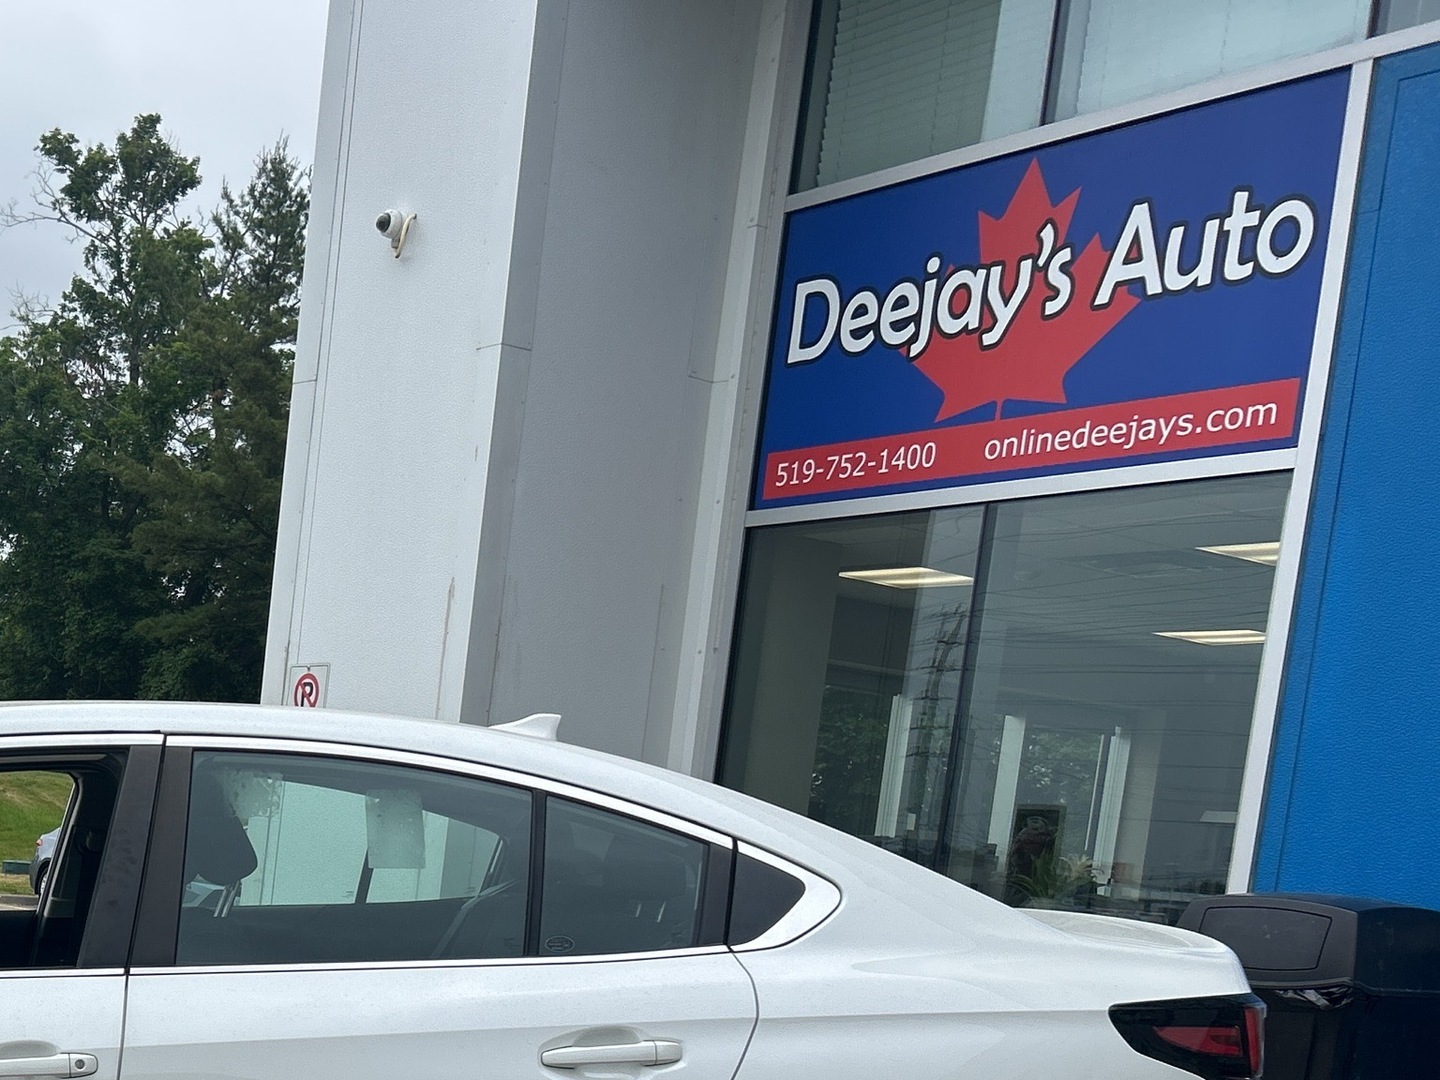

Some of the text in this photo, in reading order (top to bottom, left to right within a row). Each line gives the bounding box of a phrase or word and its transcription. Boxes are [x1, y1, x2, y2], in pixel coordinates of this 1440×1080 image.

[787, 191, 1314, 365] Deejay's Auto
[774, 400, 1279, 489] 519-752-1400 onlinedeejays.com
